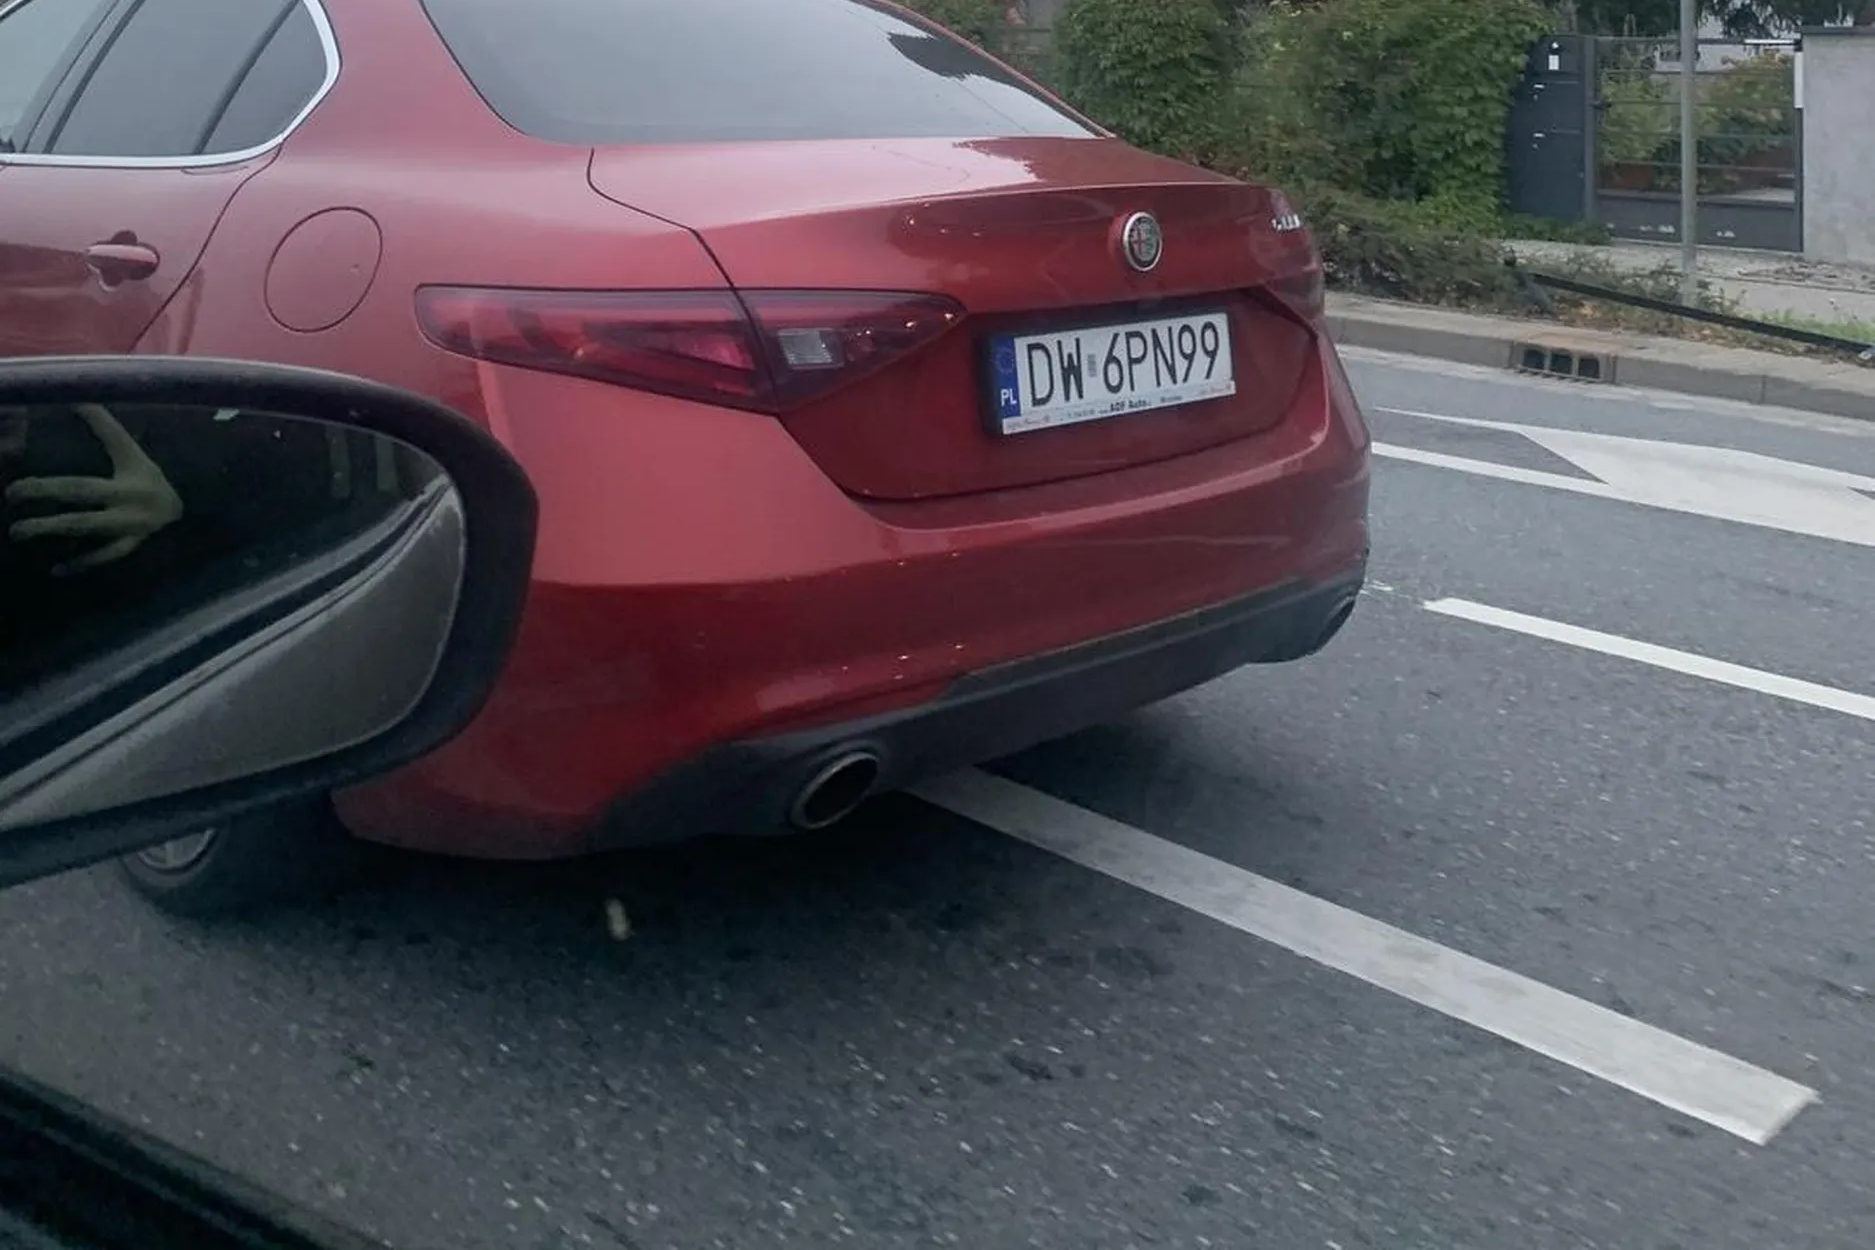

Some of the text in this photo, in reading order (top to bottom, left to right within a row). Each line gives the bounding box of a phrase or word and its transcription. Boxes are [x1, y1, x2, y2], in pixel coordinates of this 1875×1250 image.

[1026, 321, 1219, 408] DW 6PN99
[1000, 388, 1017, 406] PL
